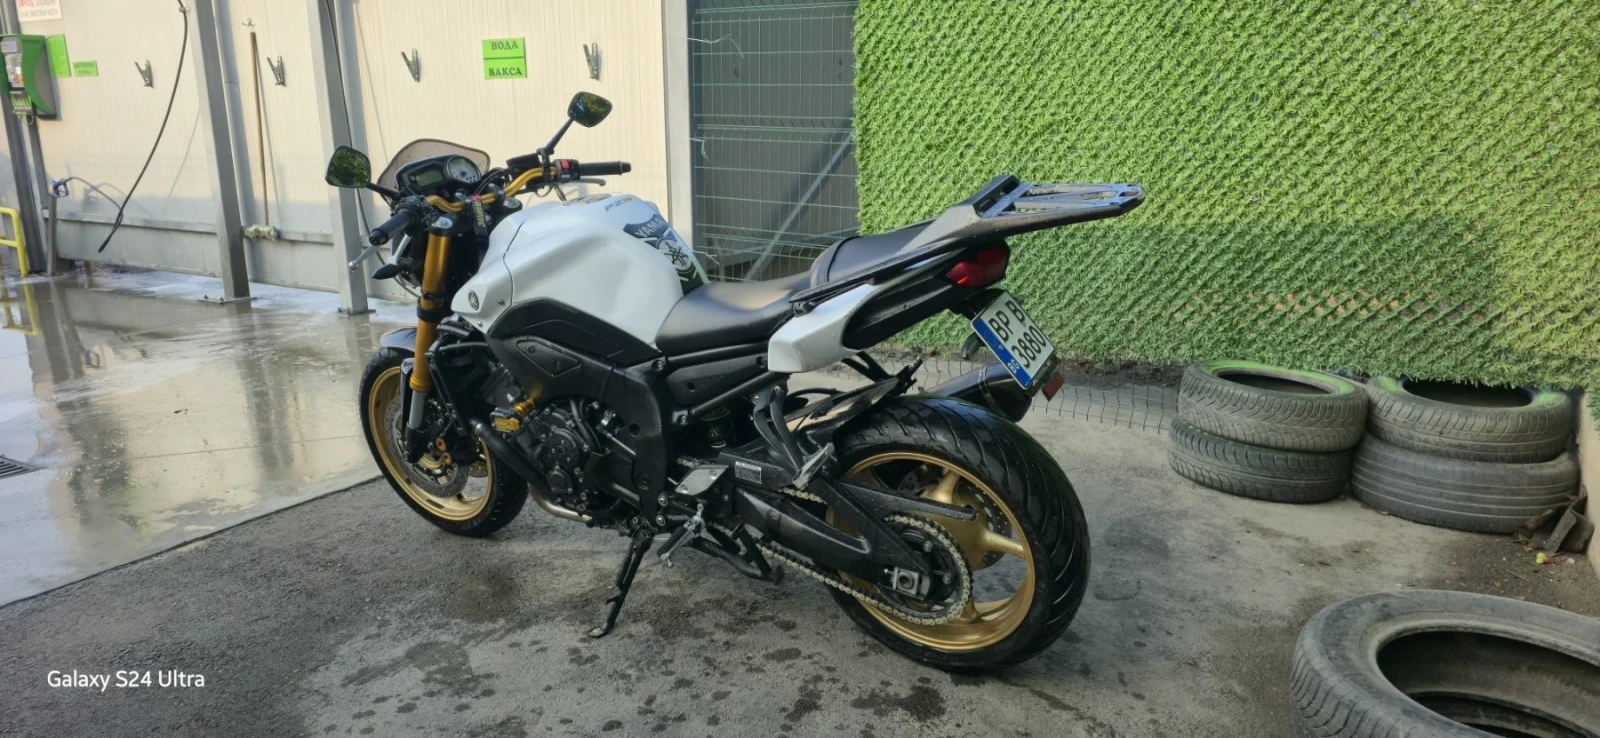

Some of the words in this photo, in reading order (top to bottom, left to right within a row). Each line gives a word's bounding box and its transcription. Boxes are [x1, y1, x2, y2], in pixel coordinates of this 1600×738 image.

[491, 40, 519, 50] ВОДА
[488, 67, 523, 77] ВАКСА
[1011, 325, 1047, 369] 3880
[1007, 358, 1020, 374] BG
